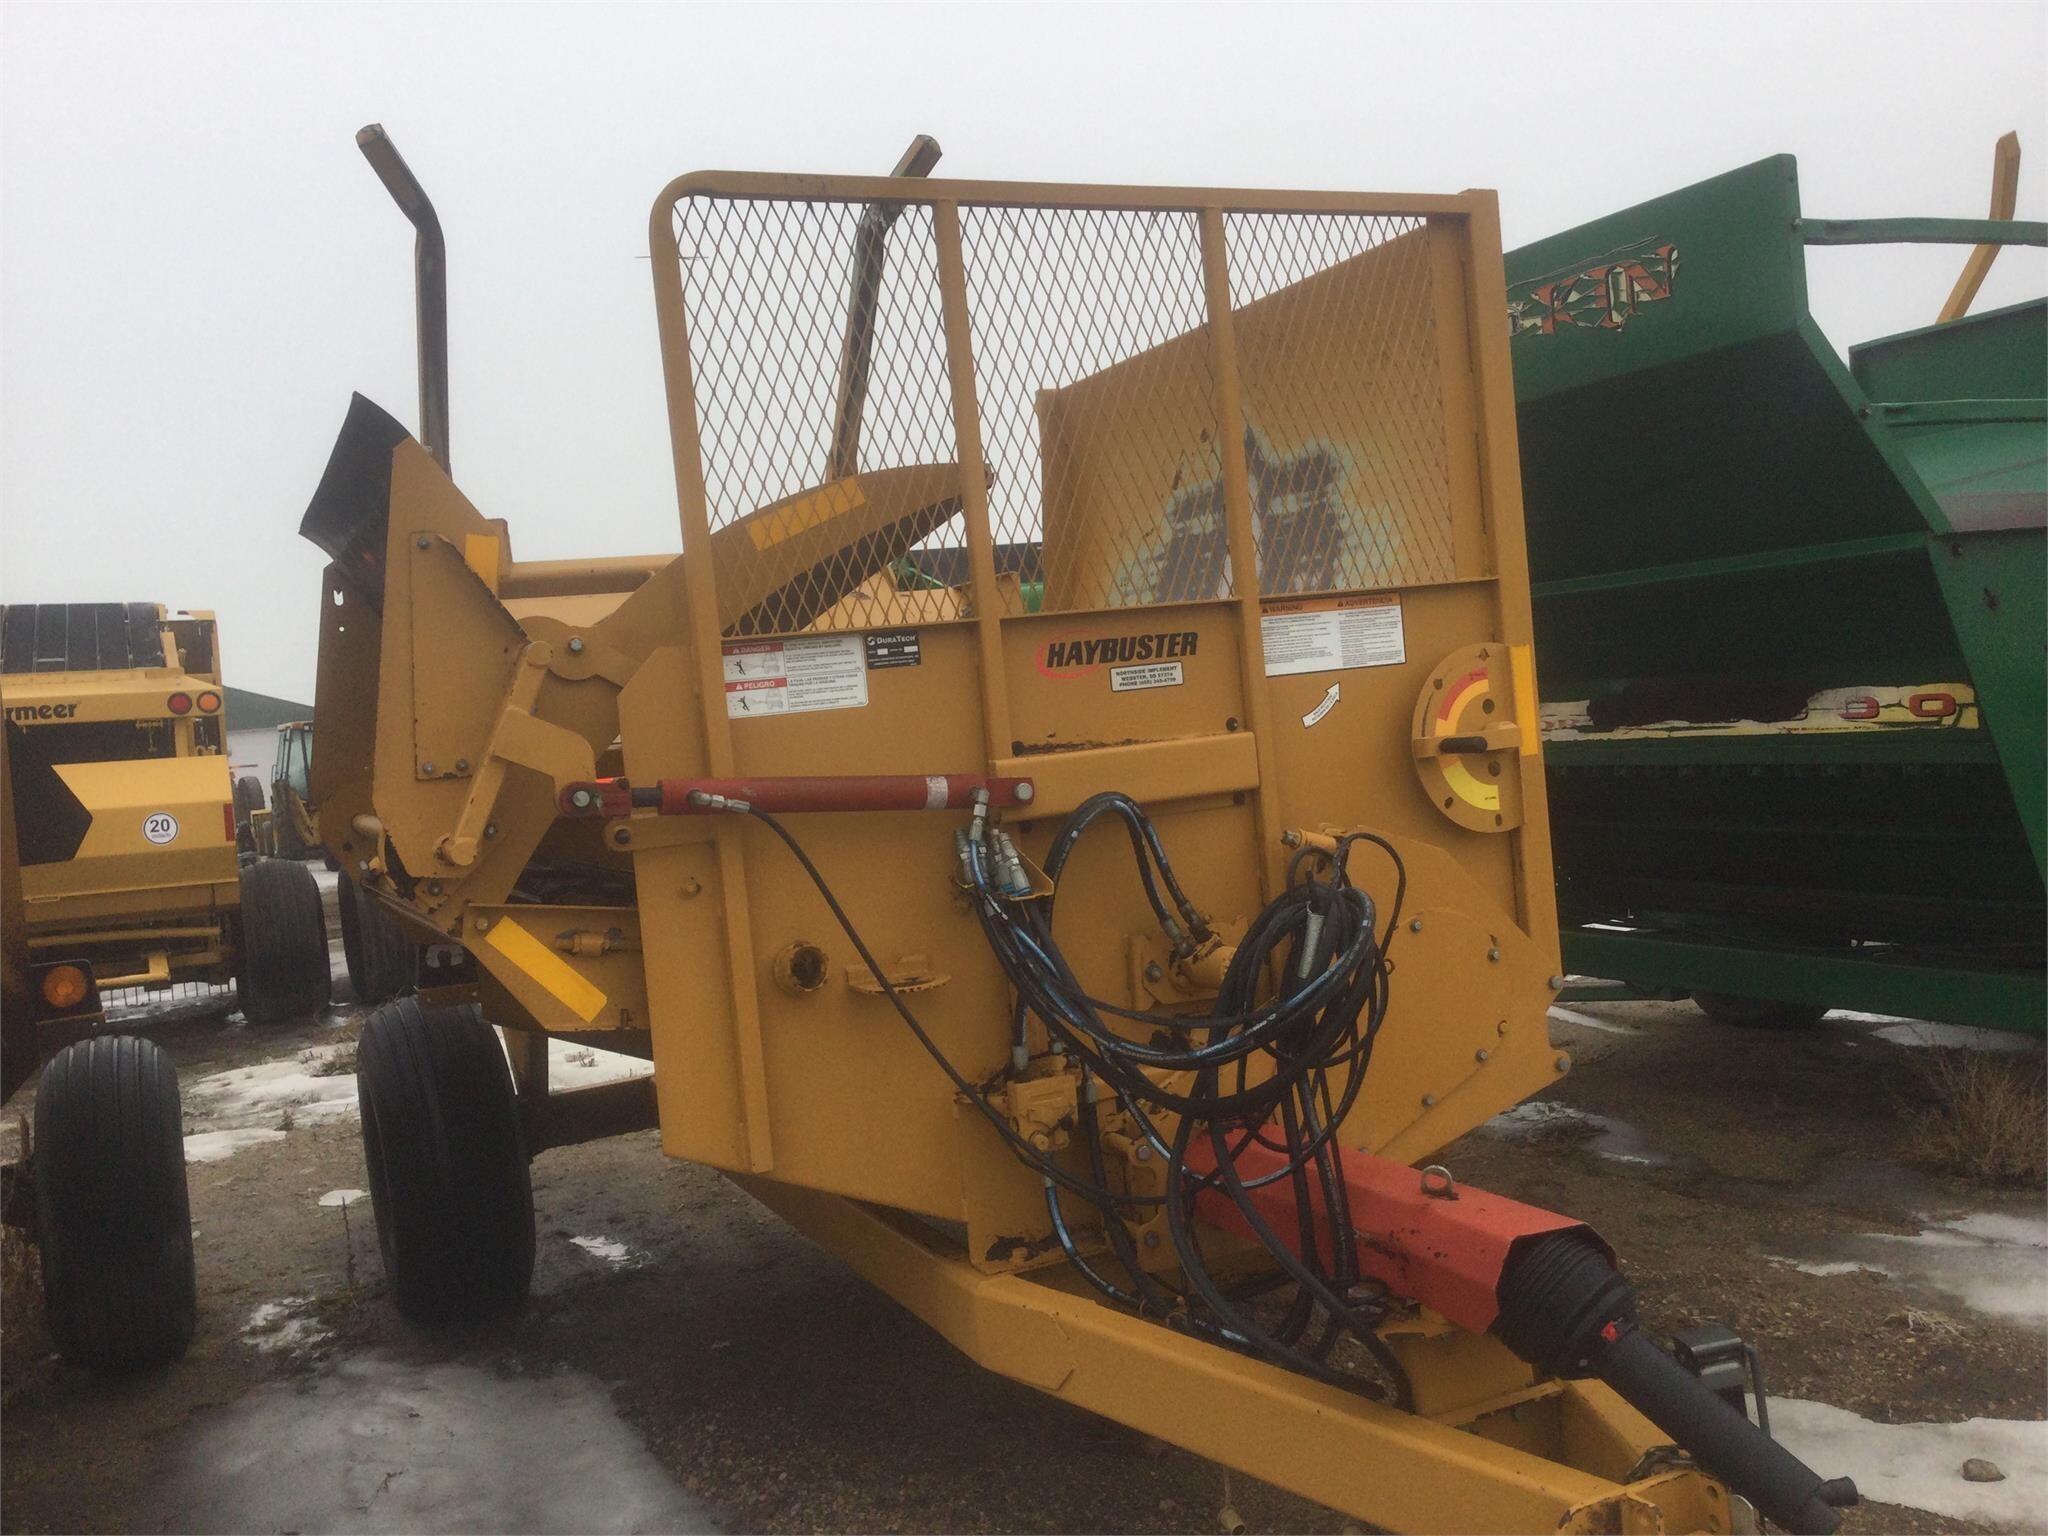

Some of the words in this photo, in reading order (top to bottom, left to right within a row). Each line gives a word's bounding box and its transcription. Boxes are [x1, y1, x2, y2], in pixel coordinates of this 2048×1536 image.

[1270, 603, 1303, 613] WARNING
[741, 645, 771, 653] DANGER
[1047, 632, 1198, 667] HAYBUSTER
[1147, 665, 1177, 673] IMPLEMENT
[743, 680, 775, 689] PELIGRO
[149, 818, 170, 833] 20
